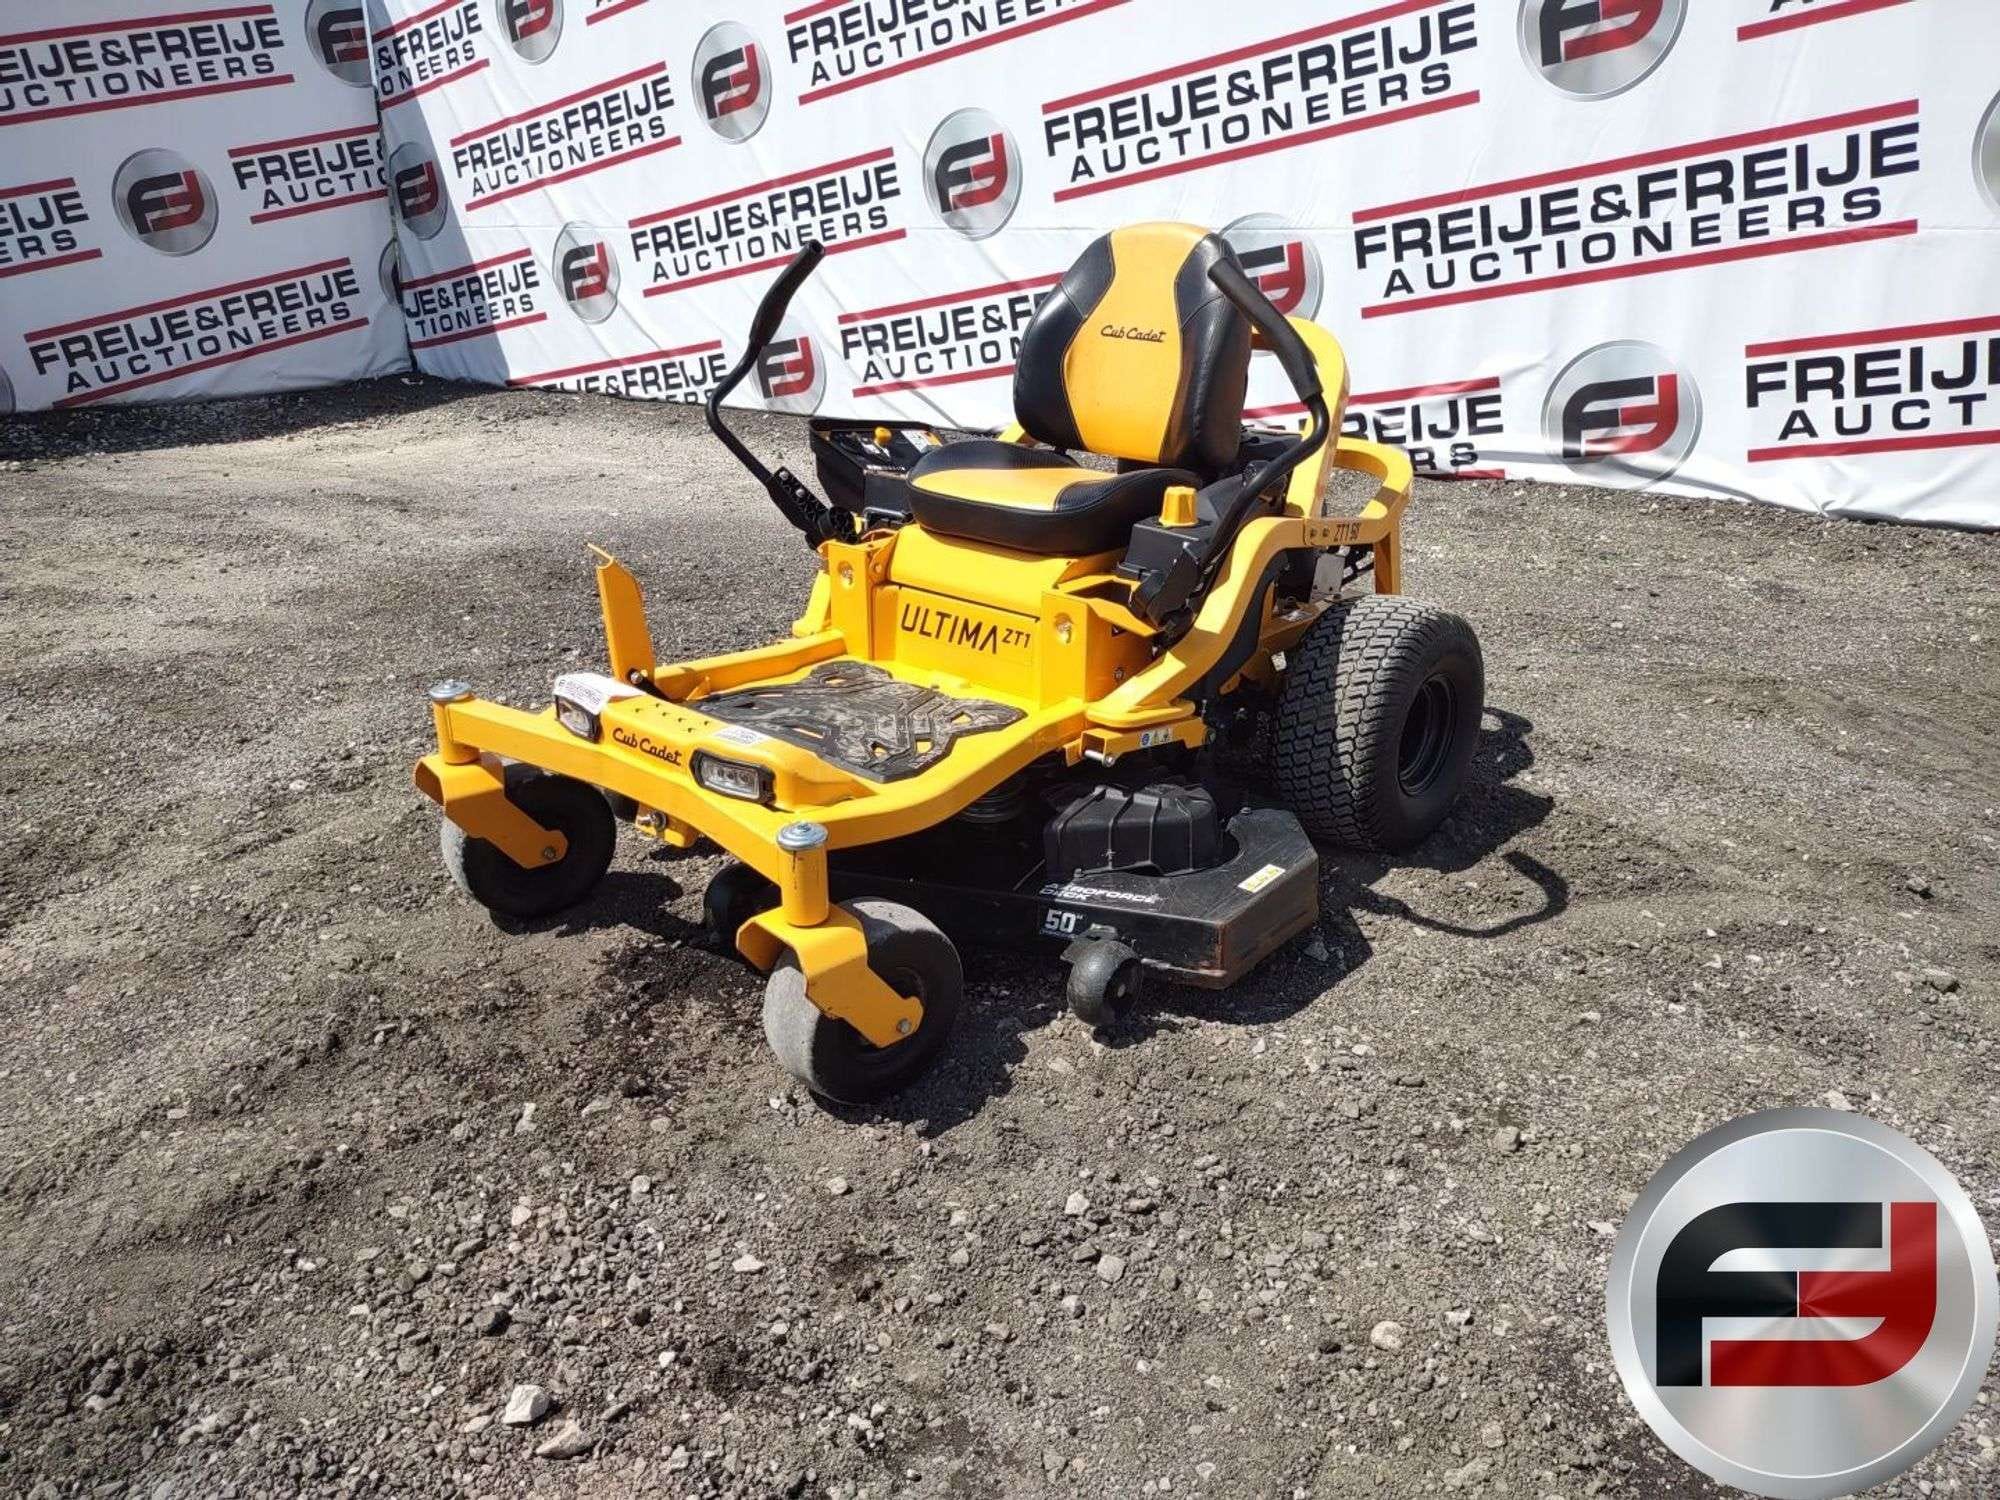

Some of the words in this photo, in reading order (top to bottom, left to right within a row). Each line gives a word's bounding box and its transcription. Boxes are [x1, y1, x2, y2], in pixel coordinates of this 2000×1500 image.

[811, 0, 1078, 86] AUCTIONEE
[1043, 3, 1478, 157] FREIJE&FREIJE
[232, 138, 383, 190] FREIJE
[453, 75, 675, 179] FREIJE&FREIJE
[472, 115, 666, 197] AUCTIONEERS
[1070, 62, 1452, 183] AUCTIONEERS
[631, 162, 901, 262] FREIJE&FREIJE
[1355, 122, 1920, 270] FREIJE&FREIJE
[652, 205, 888, 283] AUCTIONEERS
[1383, 186, 1882, 299] AUCTIONEERS
[28, 268, 360, 375] FREIJE&FREIJE
[66, 301, 351, 393] AUCTIONEERS
[1101, 325, 1125, 338] Cub
[1126, 327, 1167, 342] Cadet
[1778, 393, 1987, 441] AUCT
[901, 603, 998, 655] ULTIMA
[1001, 628, 1031, 648] ZT1
[612, 727, 638, 748] Cub
[639, 738, 682, 767] Cadet
